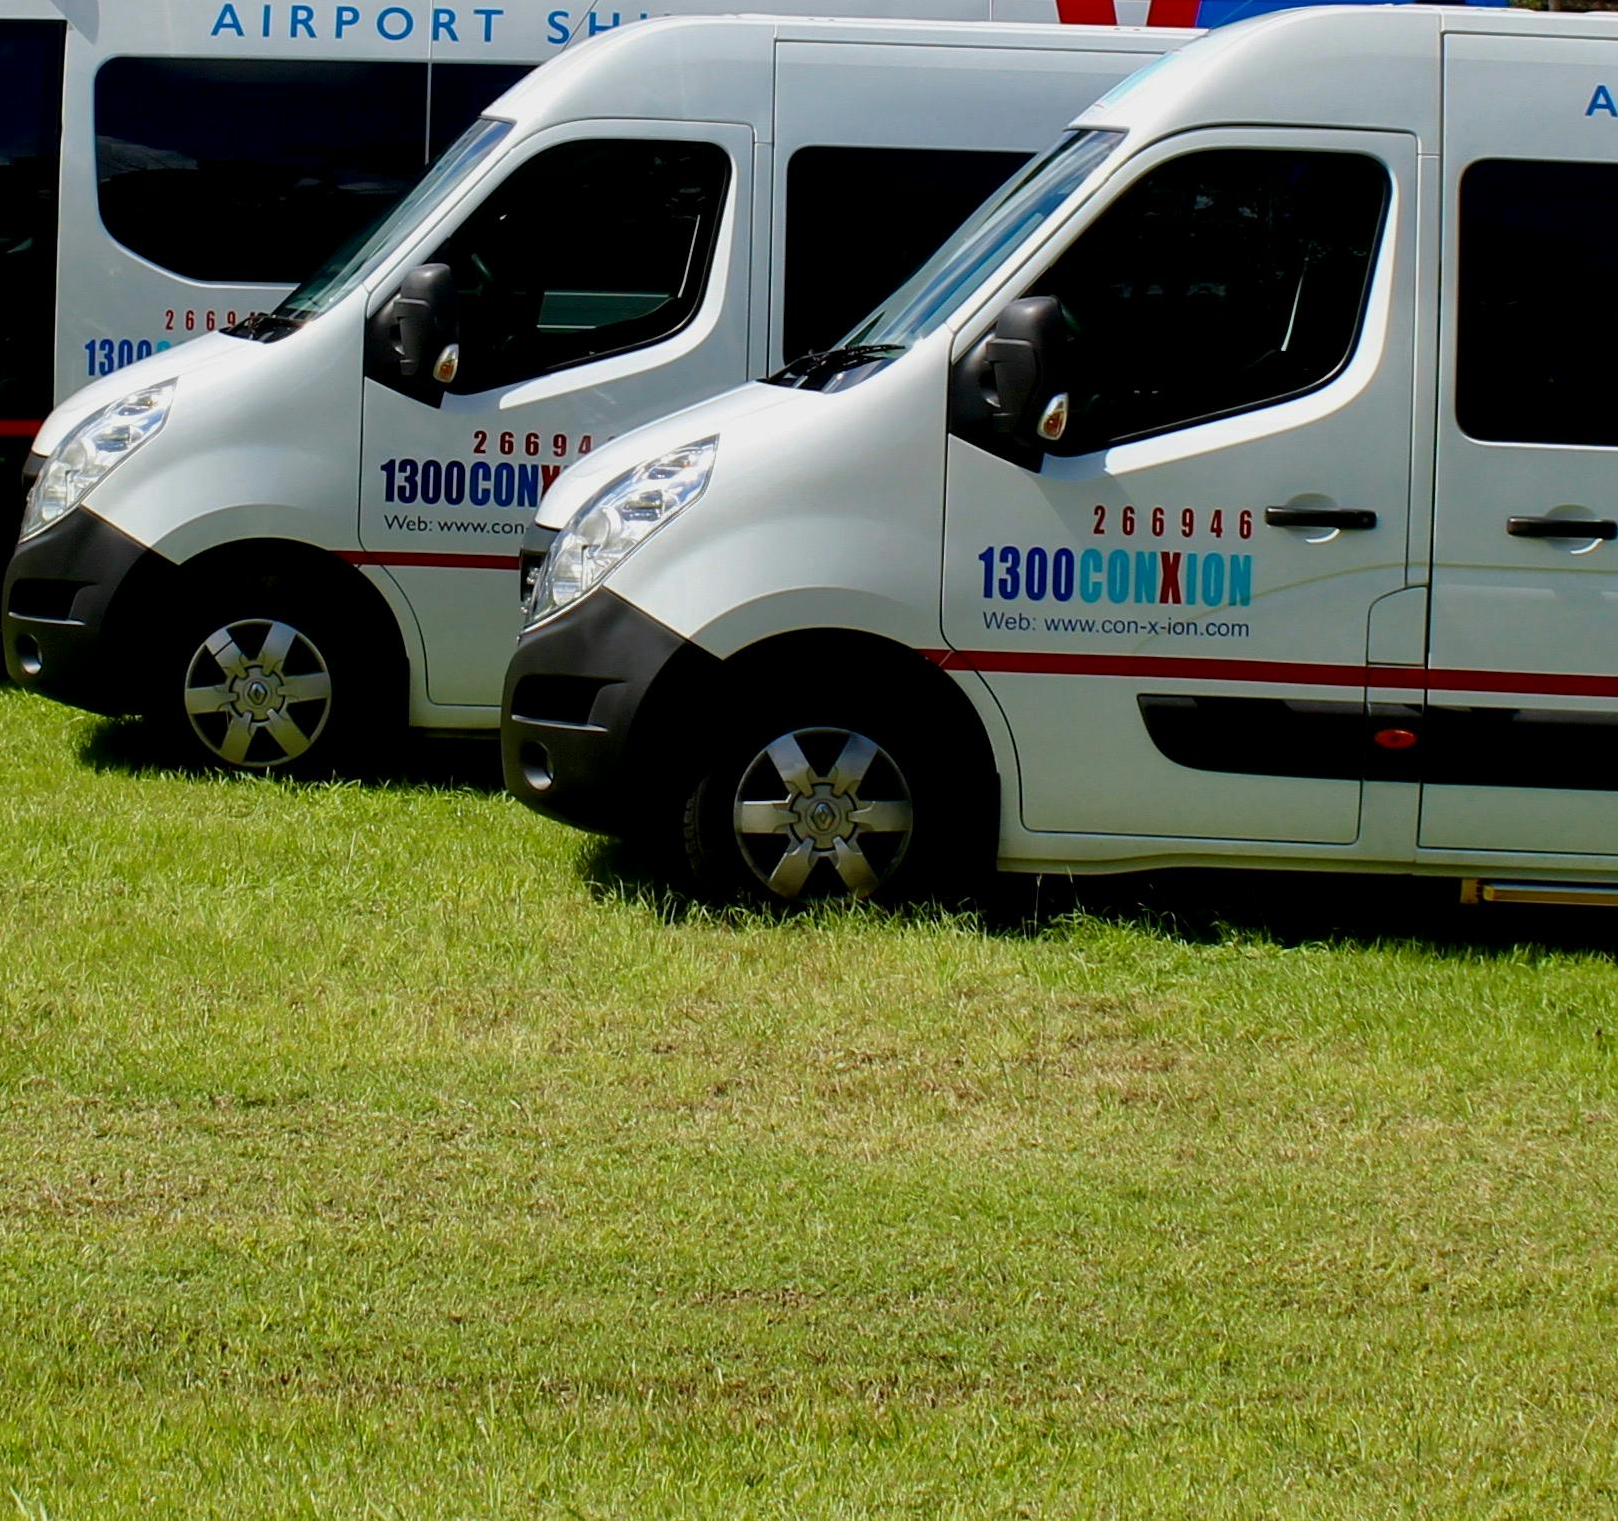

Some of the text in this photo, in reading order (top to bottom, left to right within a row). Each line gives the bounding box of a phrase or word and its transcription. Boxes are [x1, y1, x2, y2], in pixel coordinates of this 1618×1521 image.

[211, 2, 671, 44] AIRPORT SH
[85, 339, 172, 376] 1300
[473, 430, 615, 458] 26694
[384, 515, 433, 532] Web:
[1093, 505, 1252, 540] 266946
[978, 546, 1252, 607] 1300CONXION
[982, 611, 1250, 637] Web: www.con-x-ion.com
